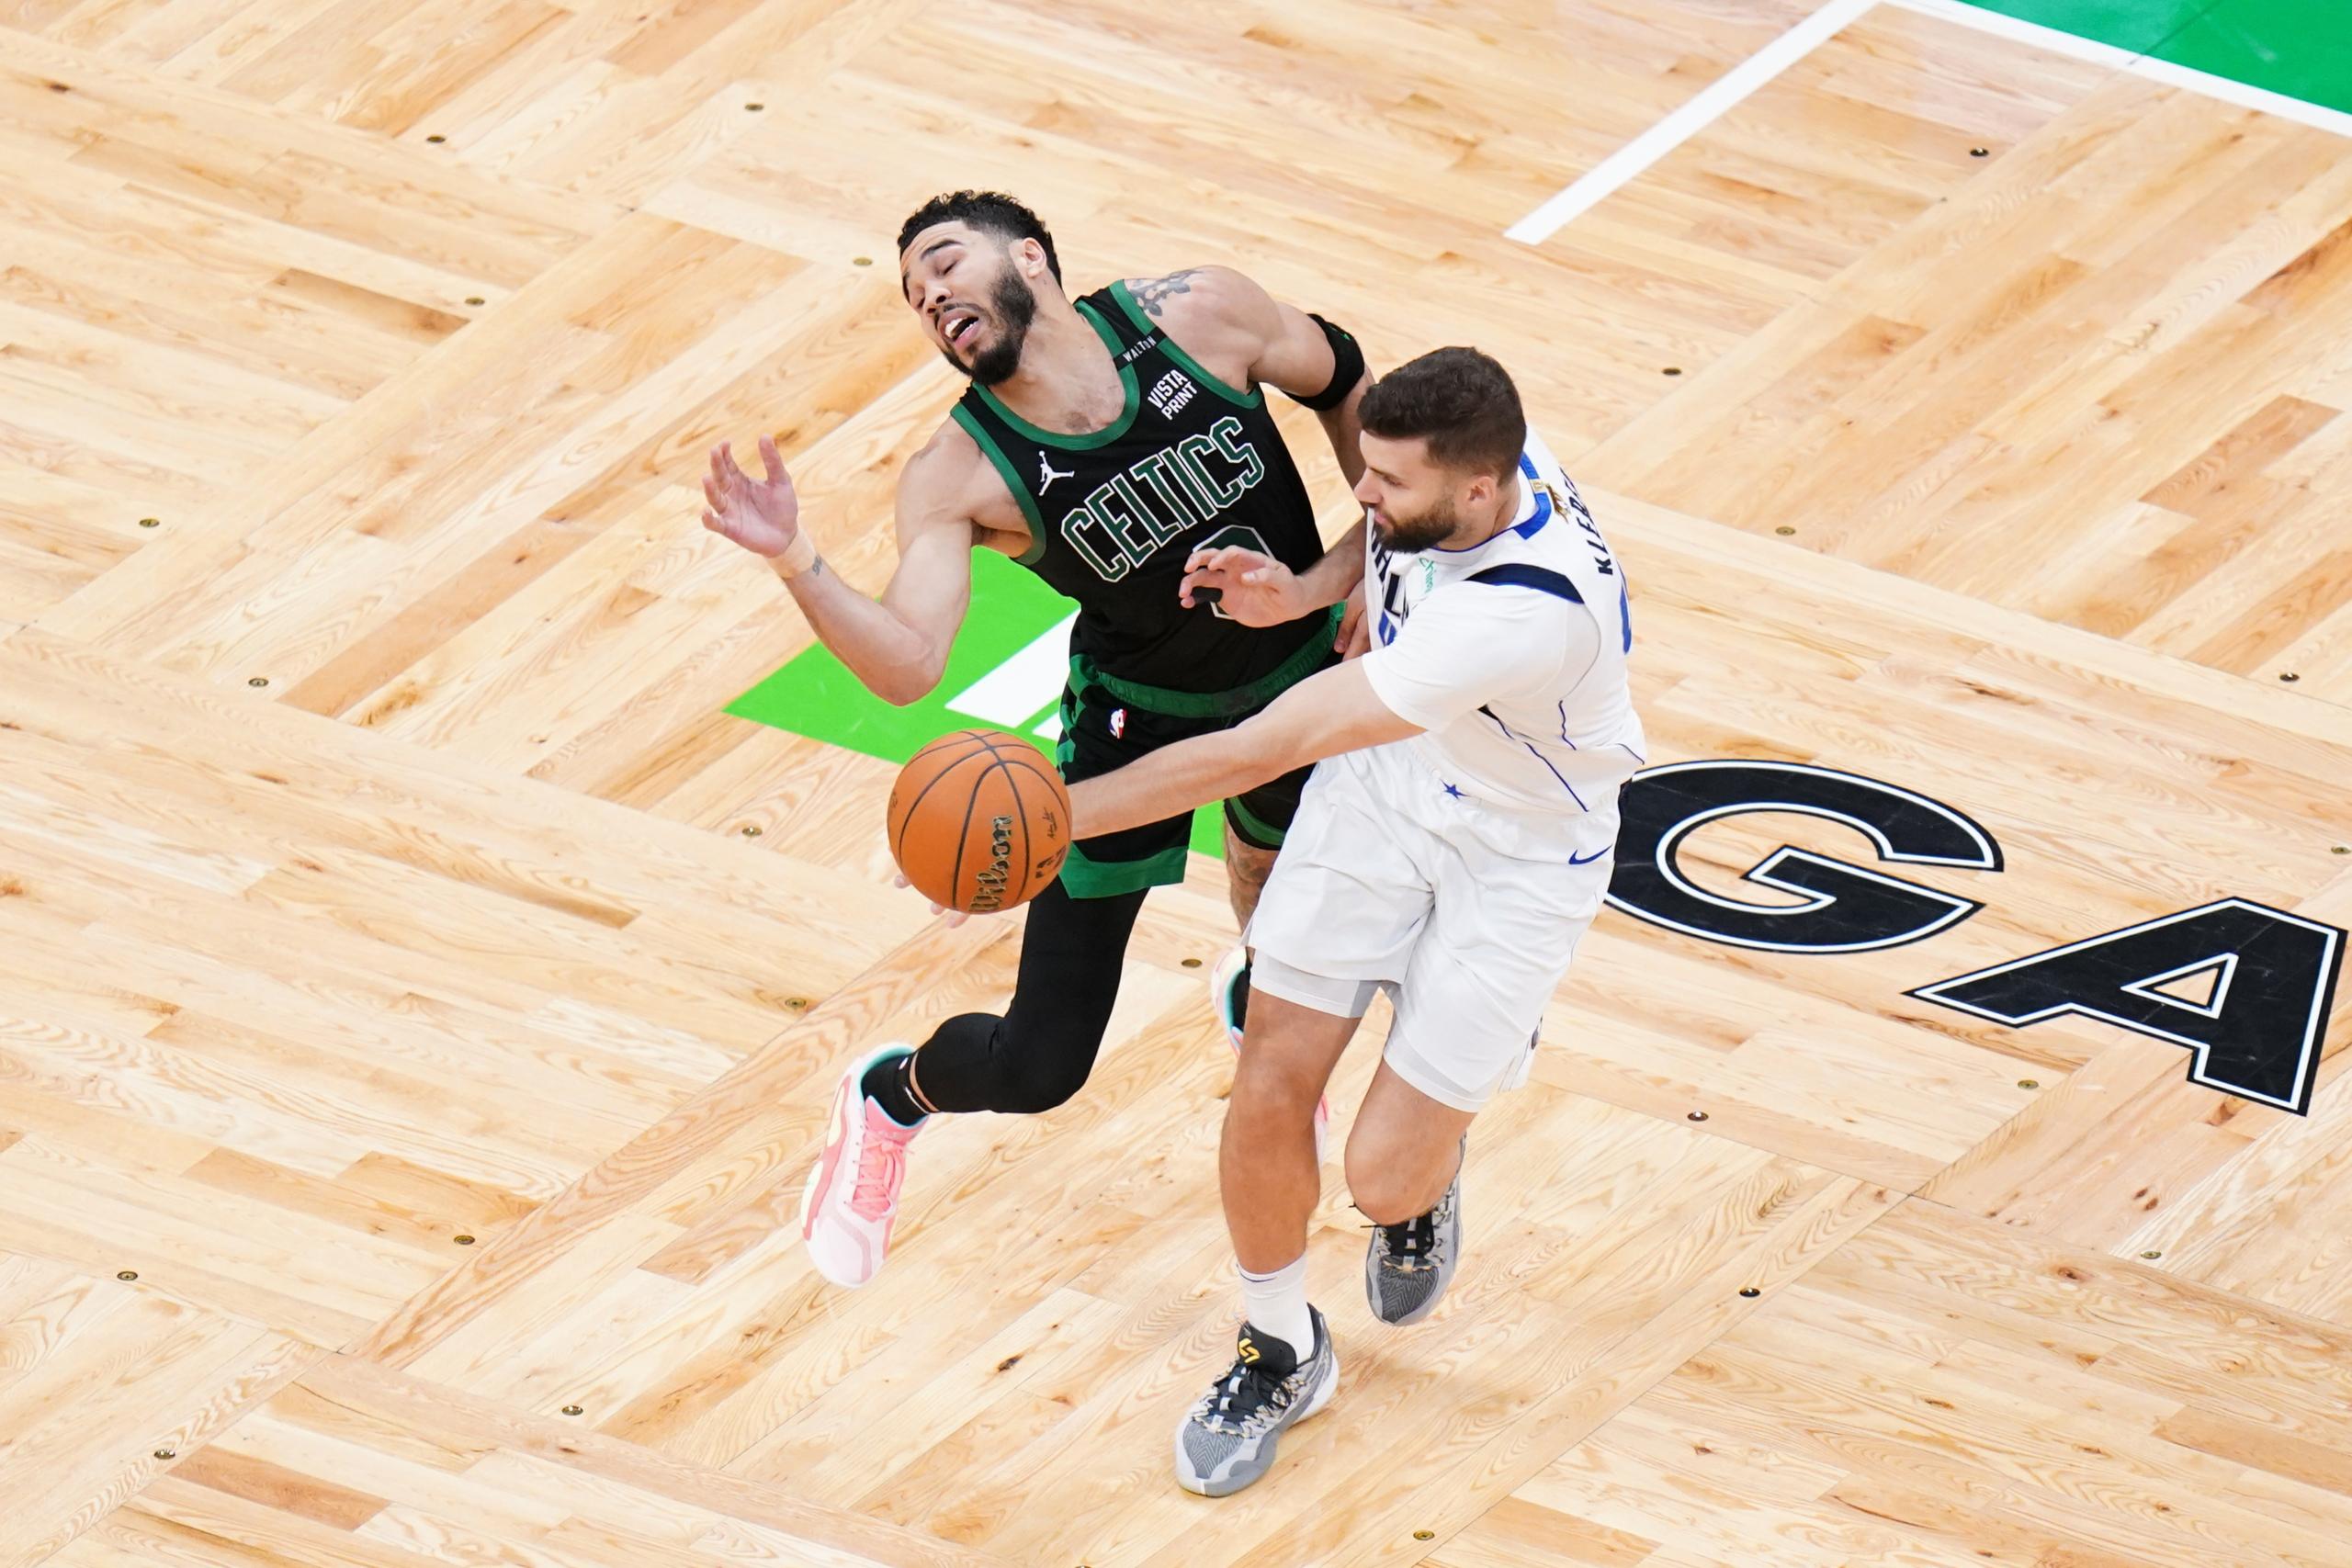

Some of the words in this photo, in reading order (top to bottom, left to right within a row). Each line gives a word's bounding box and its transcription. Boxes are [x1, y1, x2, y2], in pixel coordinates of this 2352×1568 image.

[1123, 335, 1157, 362] WALTON
[1148, 369, 1188, 409] VISTA
[1161, 381, 1197, 421] PRINT
[1060, 416, 1265, 582] CELTICS
[968, 815, 1013, 912] Wilson
